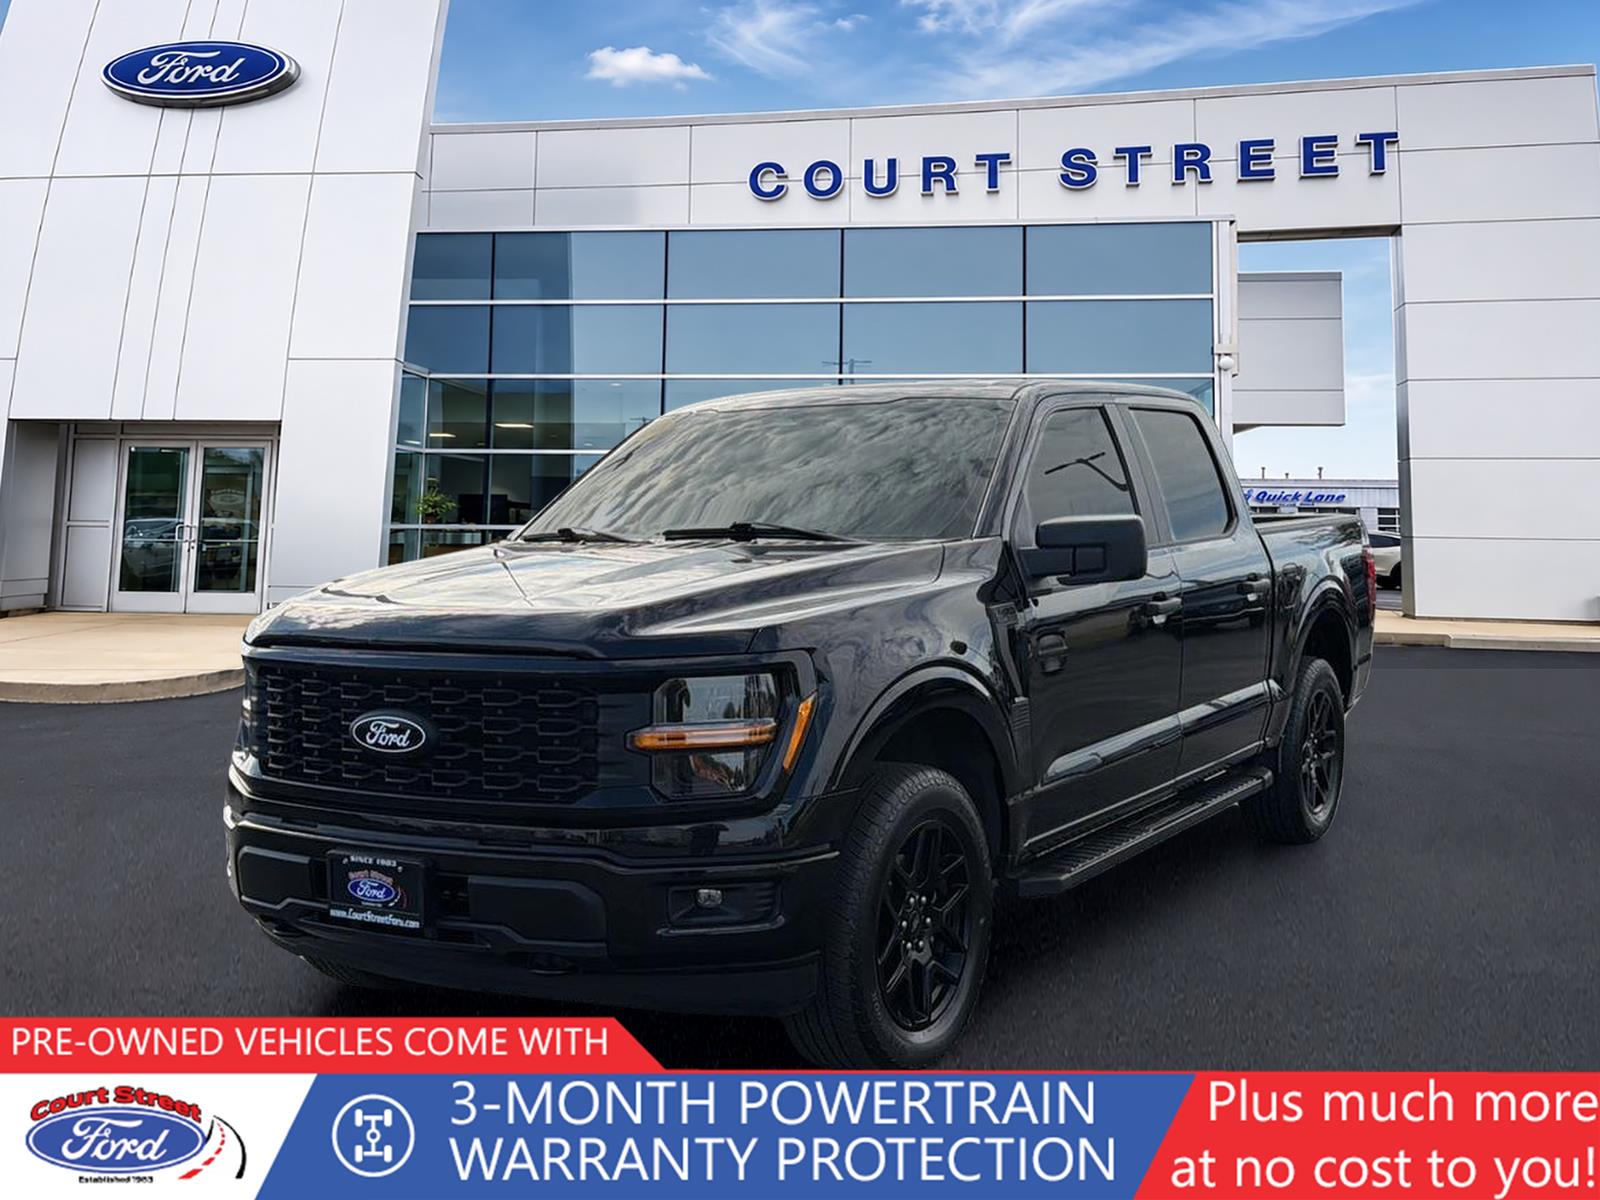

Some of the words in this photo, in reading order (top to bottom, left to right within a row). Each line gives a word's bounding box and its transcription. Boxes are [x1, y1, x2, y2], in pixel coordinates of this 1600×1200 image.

[137, 50, 246, 85] Ford
[748, 152, 1011, 200] COURT
[1059, 131, 1399, 187] STREET
[1255, 490, 1302, 504] Quick
[1304, 491, 1346, 503] Lane
[366, 721, 411, 747] Ford
[350, 855, 374, 865] SINCE
[356, 880, 386, 898] Ford
